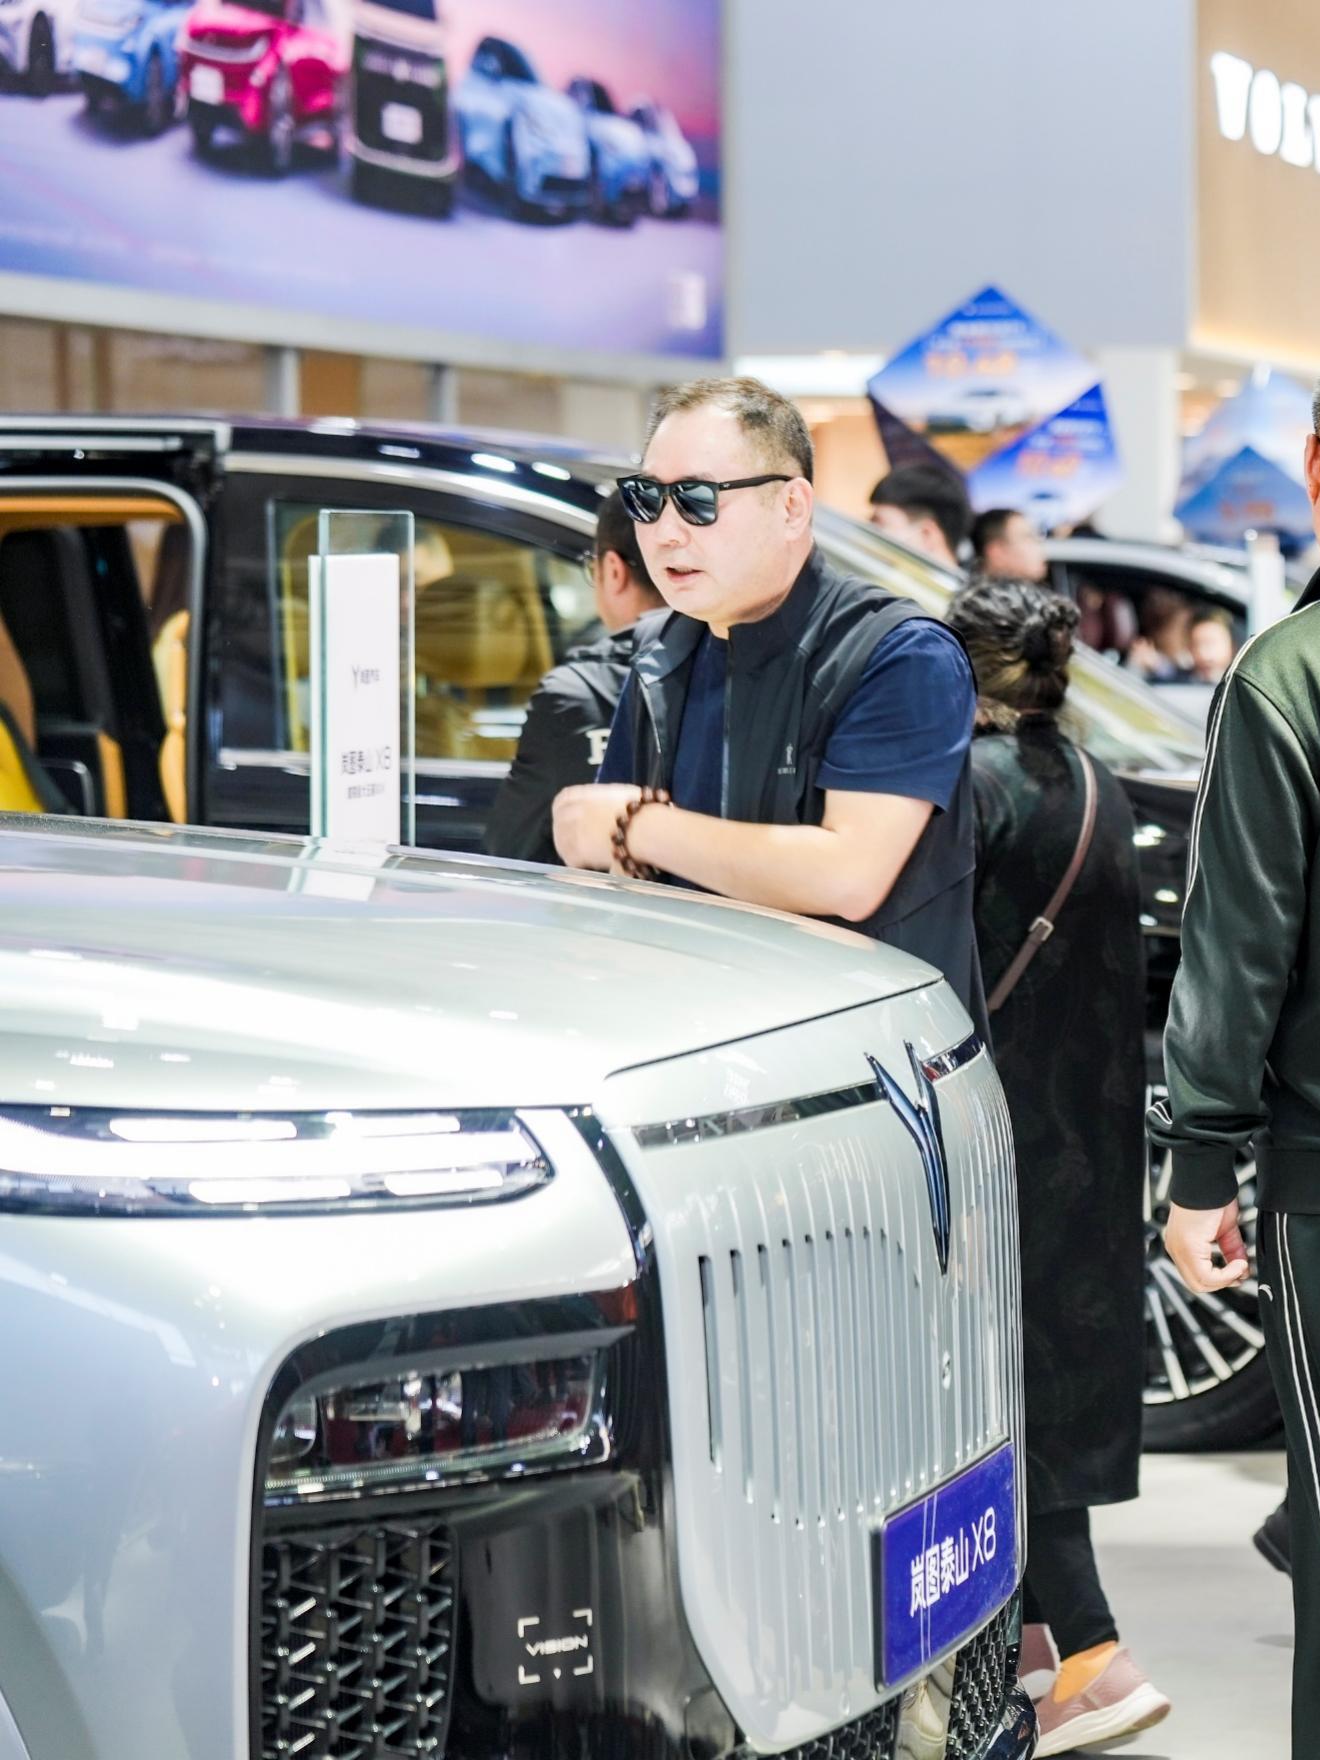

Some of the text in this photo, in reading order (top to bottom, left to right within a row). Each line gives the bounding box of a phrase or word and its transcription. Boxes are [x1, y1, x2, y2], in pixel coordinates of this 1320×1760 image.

[910, 1506, 997, 1618] 岚图泰山 X8
[525, 1634, 588, 1656] VISION
